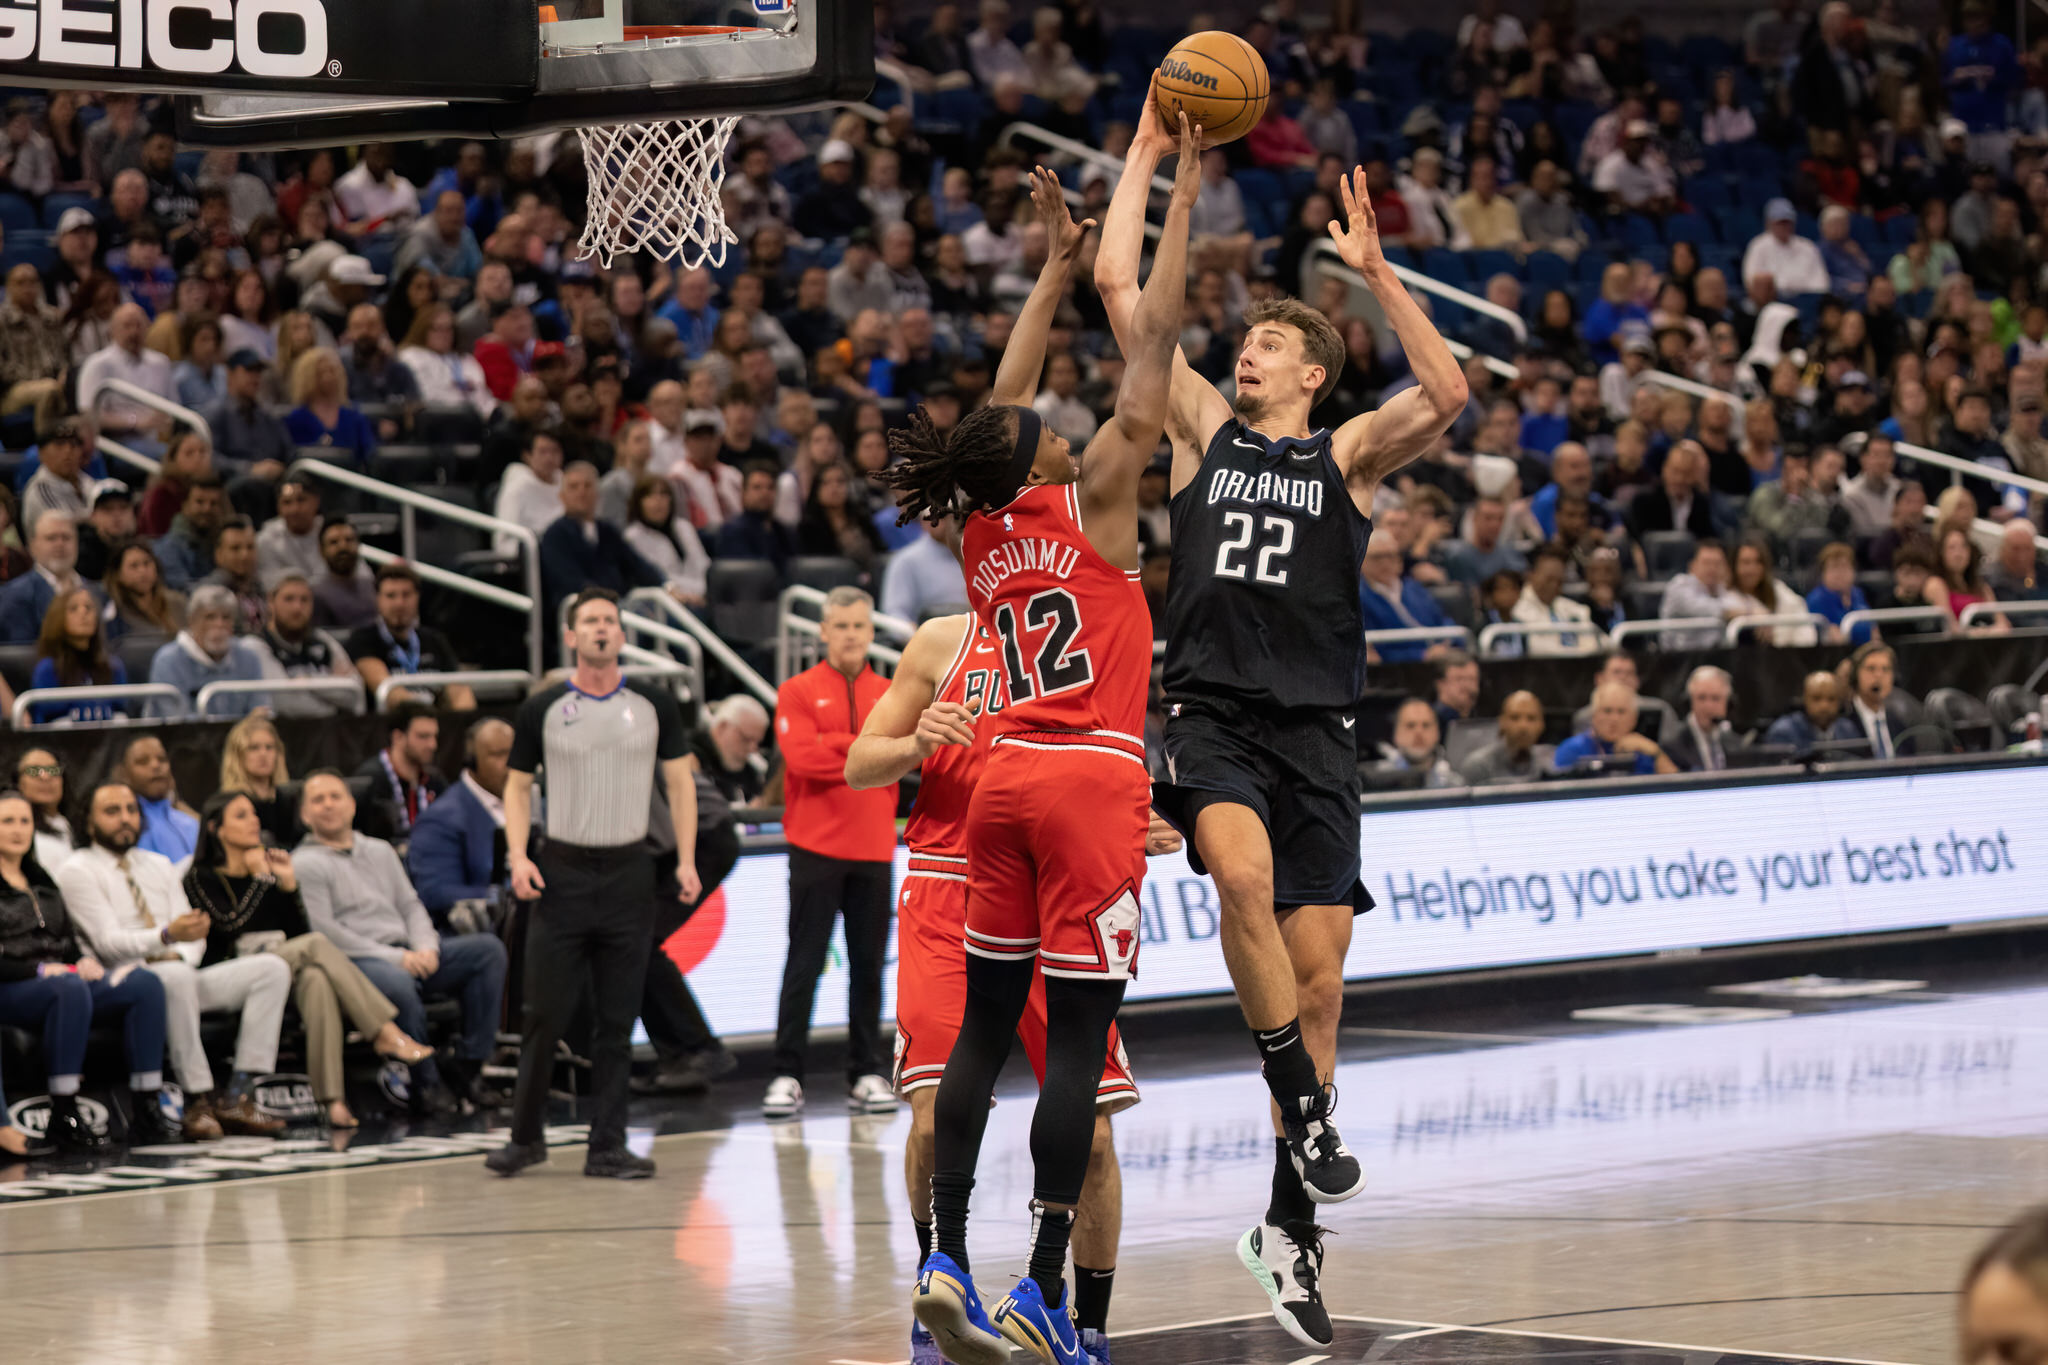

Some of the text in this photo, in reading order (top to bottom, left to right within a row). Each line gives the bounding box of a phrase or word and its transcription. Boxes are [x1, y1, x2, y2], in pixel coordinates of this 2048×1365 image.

[1160, 58, 1219, 92] Wilson
[1207, 468, 1323, 517] ORLANDO
[972, 538, 1081, 604] DOSUNMU
[1214, 511, 1295, 585] 22
[994, 586, 1094, 707] 12
[1384, 827, 2016, 930] Helping you take your best shot
